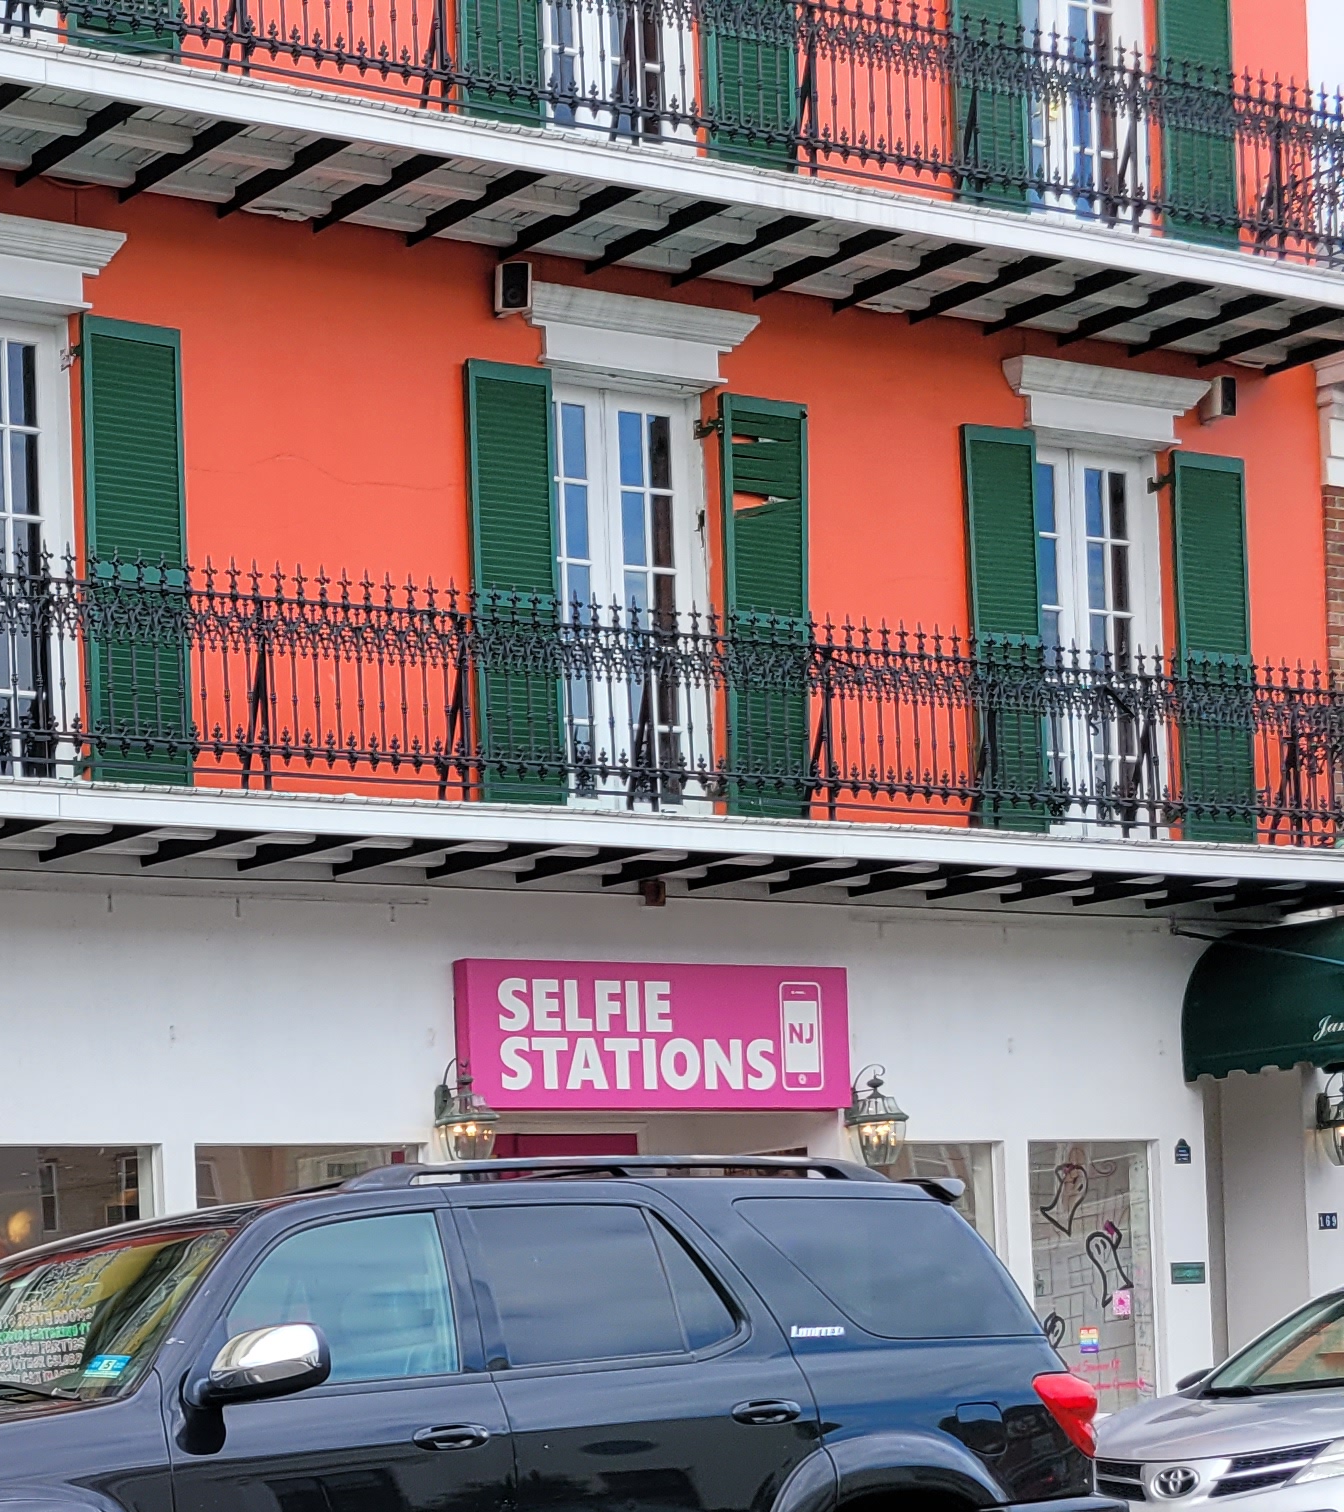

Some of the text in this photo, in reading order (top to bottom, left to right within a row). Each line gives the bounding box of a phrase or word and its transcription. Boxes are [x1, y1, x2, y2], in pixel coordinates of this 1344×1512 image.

[498, 977, 673, 1033] SELFIE
[787, 1022, 815, 1044] NJ
[500, 1037, 777, 1090] STATIONS
[1319, 1215, 1337, 1227] 169
